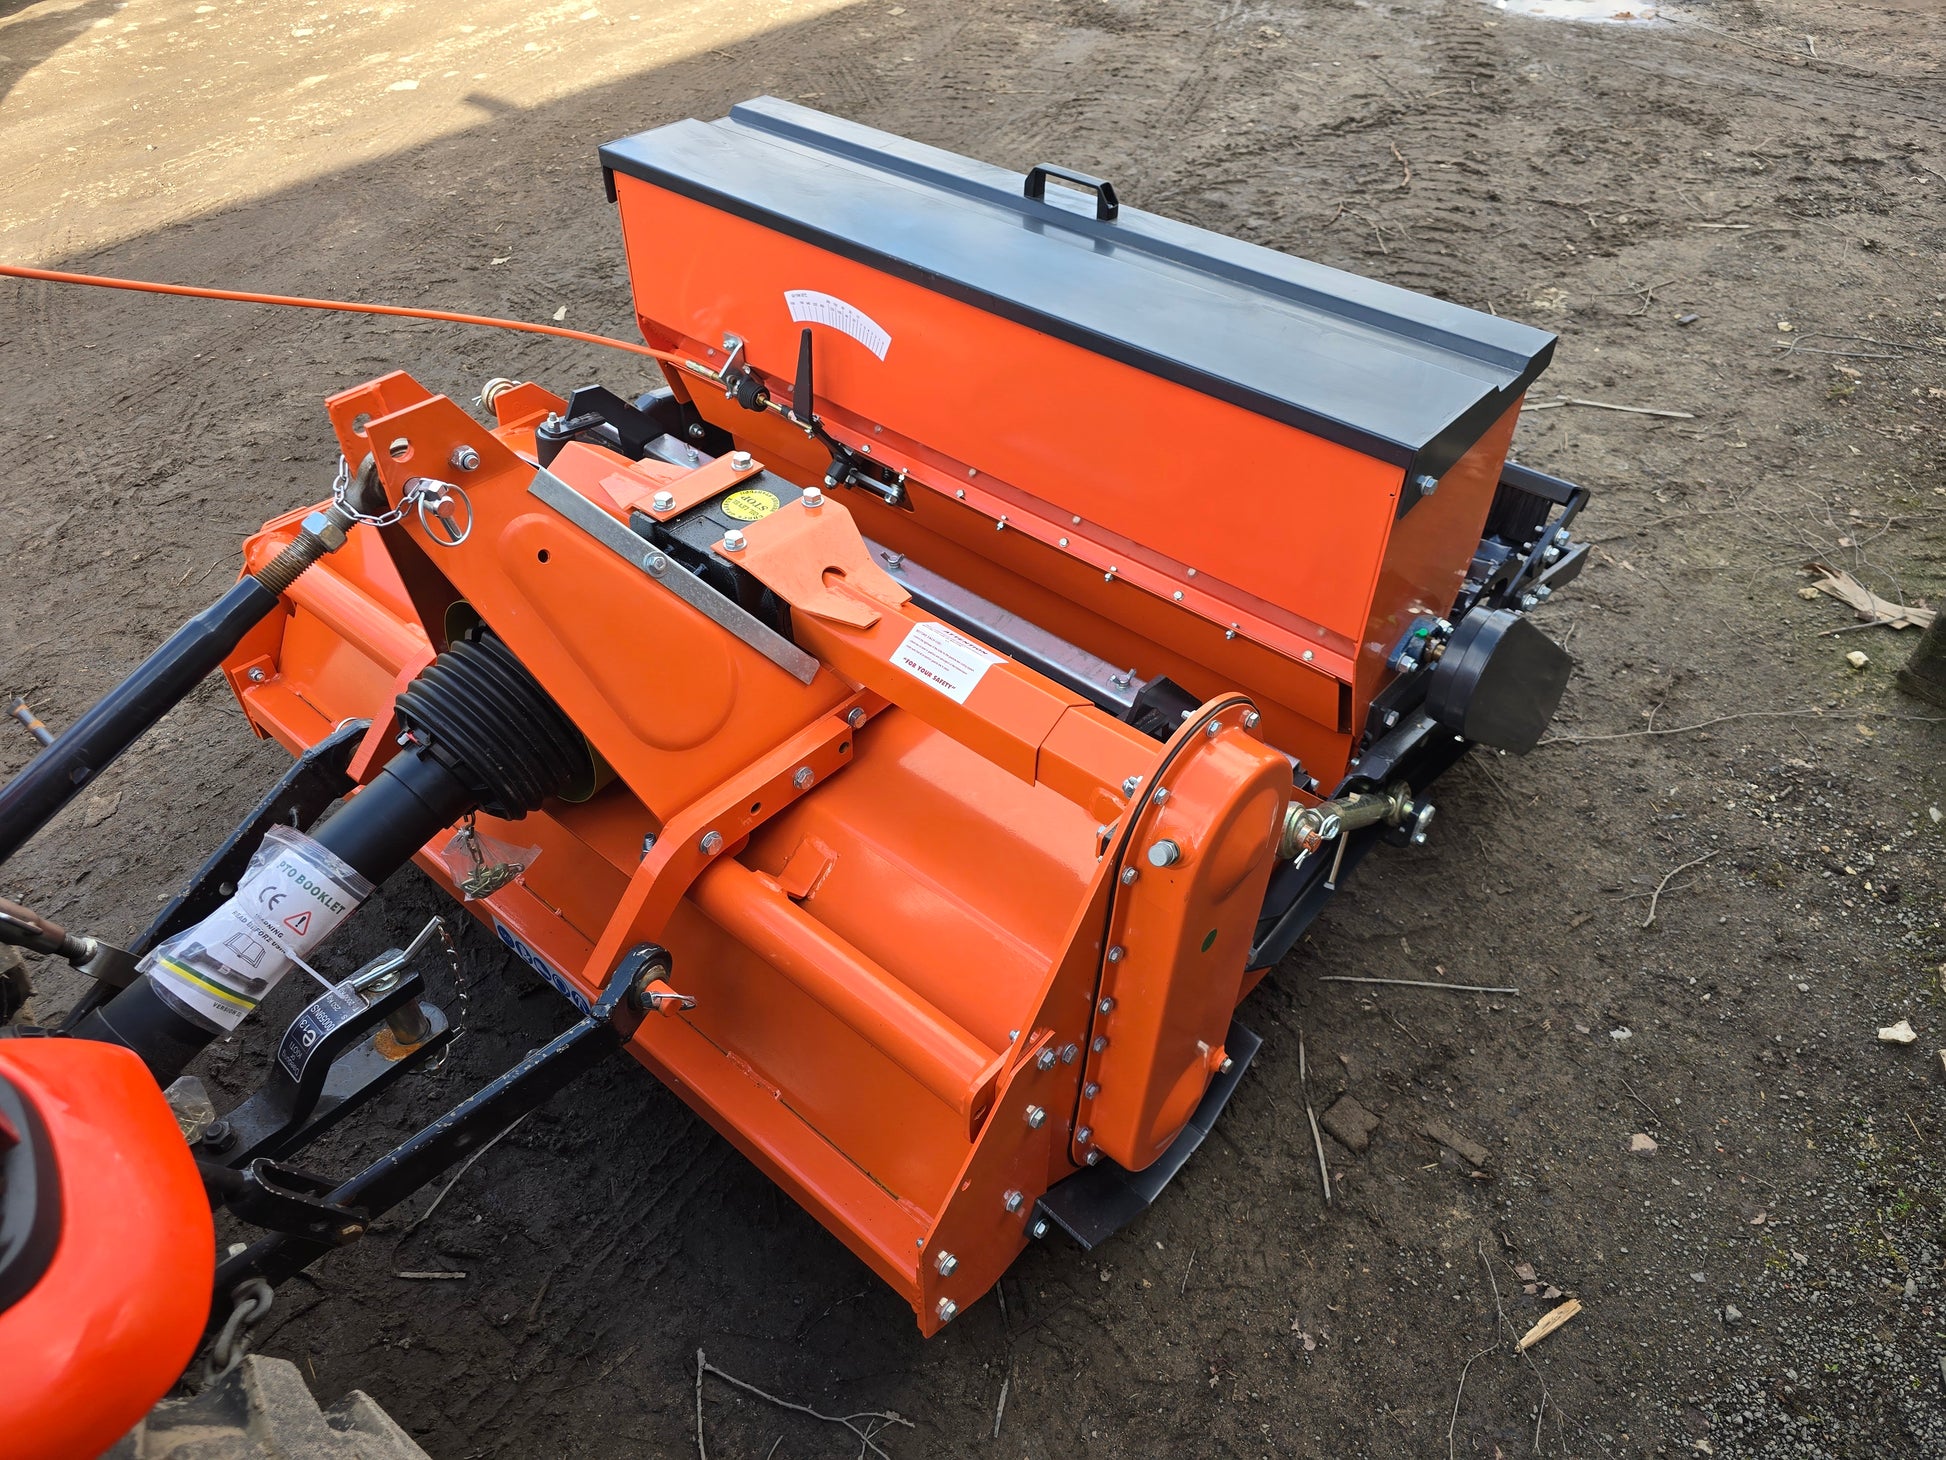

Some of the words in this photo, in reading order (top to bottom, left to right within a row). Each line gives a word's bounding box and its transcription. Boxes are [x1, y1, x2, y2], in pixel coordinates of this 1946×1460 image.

[740, 494, 769, 512] STOP
[943, 630, 988, 655] ATTENTION
[917, 664, 933, 678] YOUR
[275, 859, 297, 879] PTO
[295, 870, 347, 915] BOOKLET
[310, 1004, 336, 1031] 00059NS
[330, 1002, 342, 1013] 250
